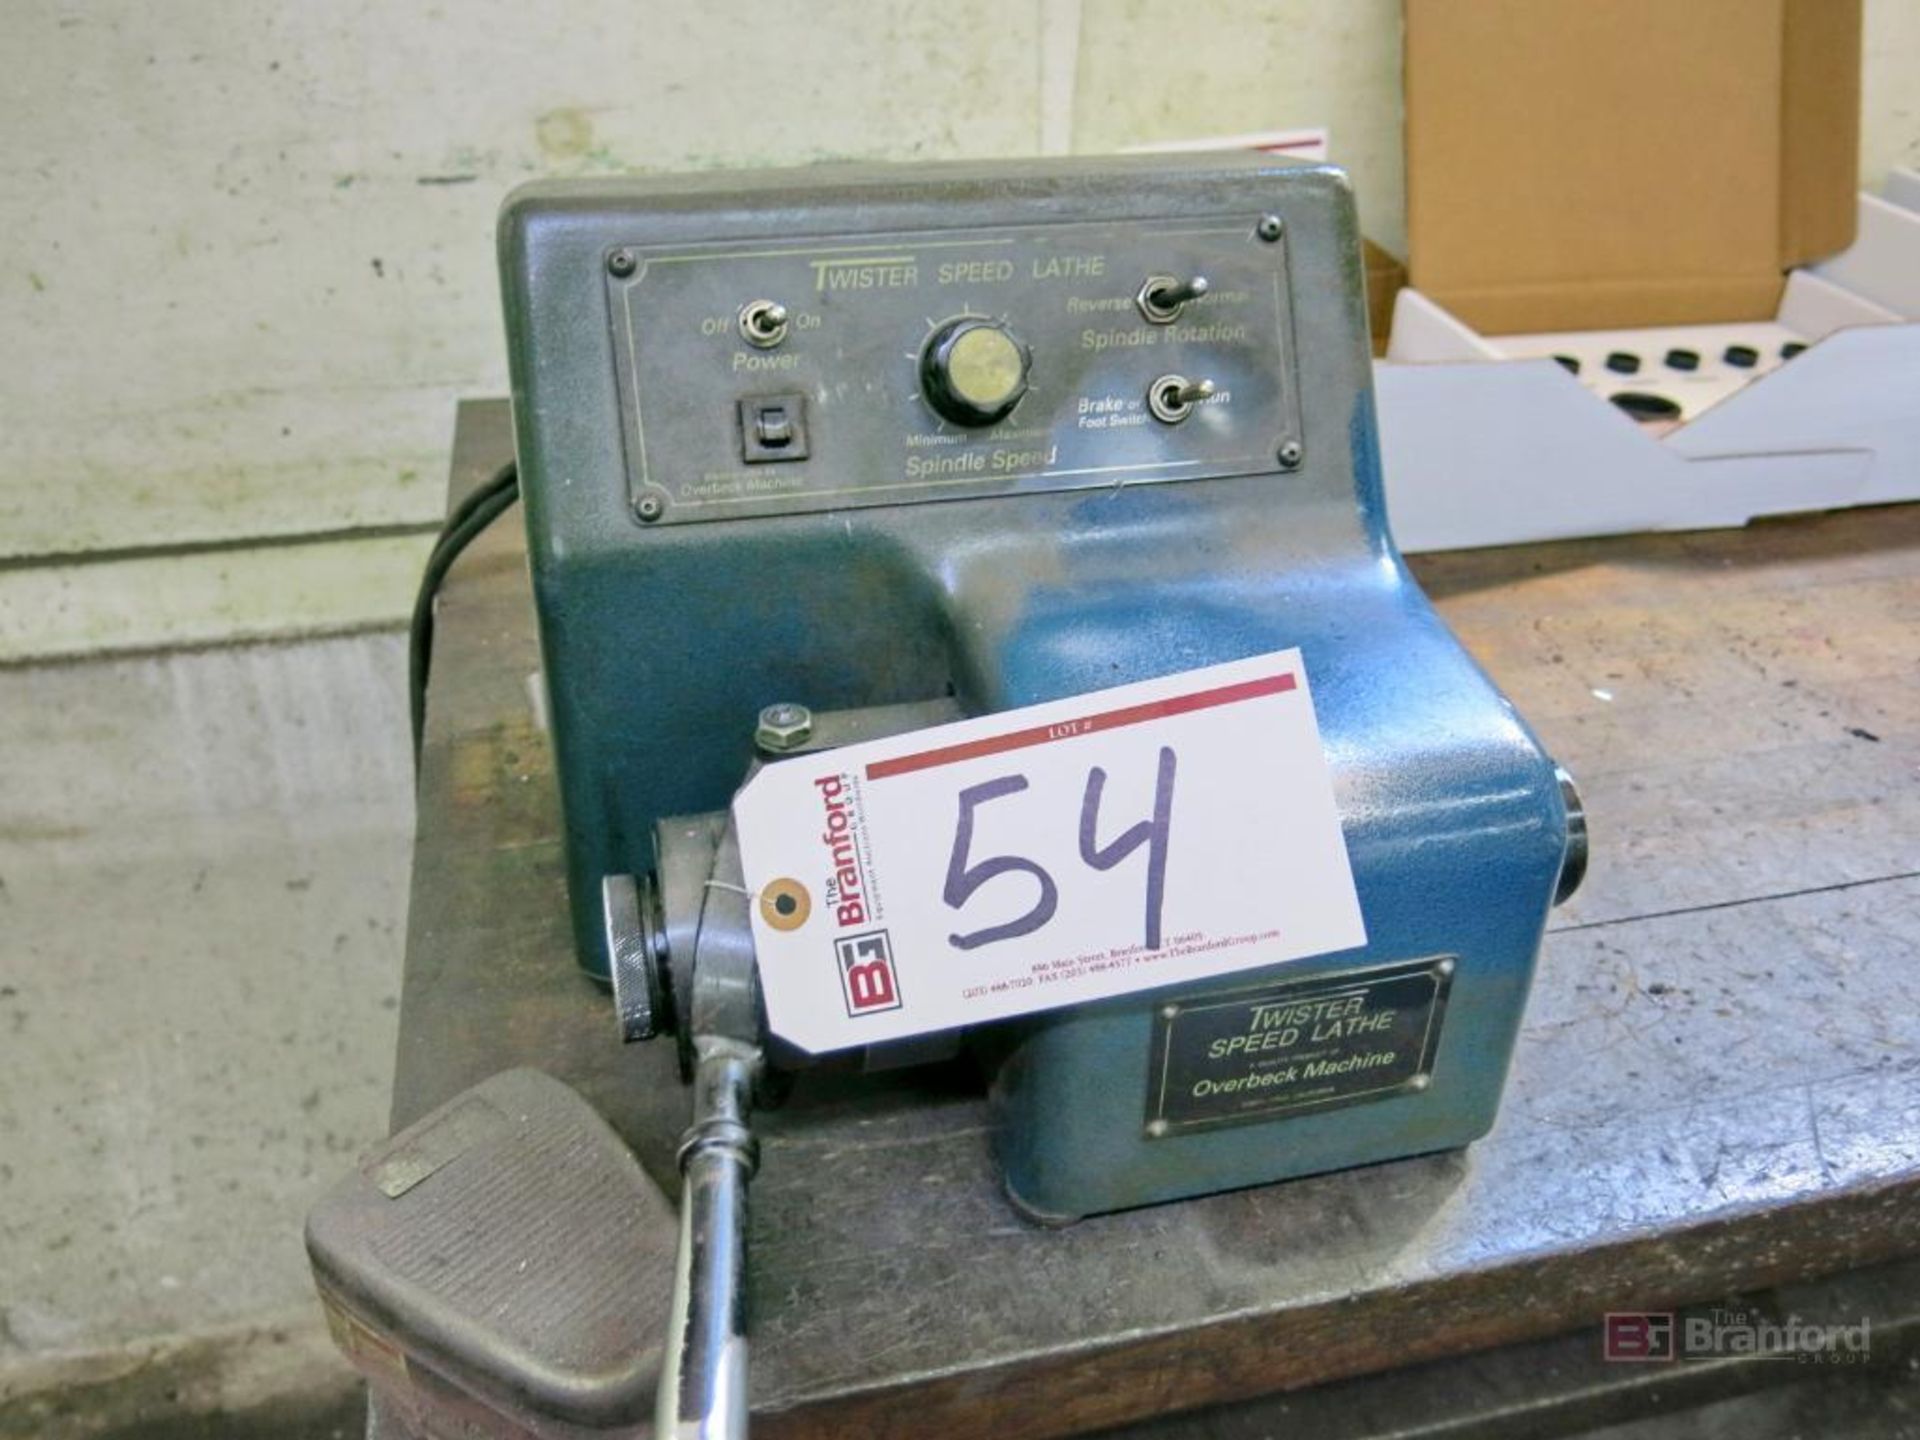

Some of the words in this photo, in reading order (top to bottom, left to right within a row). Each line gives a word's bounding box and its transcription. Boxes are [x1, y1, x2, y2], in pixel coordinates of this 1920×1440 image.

[810, 256, 919, 291] TWISTER
[938, 262, 1014, 285] SPEED
[1032, 256, 1105, 278] LATHE
[1066, 297, 1132, 313] Reverse
[702, 318, 729, 335] Off
[796, 312, 821, 329] On
[1081, 328, 1158, 350] Spindle
[1164, 322, 1246, 344] Rotation
[732, 352, 800, 372] Power
[1078, 395, 1123, 414] Brake
[1078, 415, 1107, 429] Foot
[905, 433, 968, 448] Minimum
[905, 452, 986, 478] Spindle
[991, 444, 1058, 472] Speed
[1049, 722, 1077, 739] LOT
[841, 773, 858, 830] GROUP
[814, 774, 865, 927] Branford
[943, 746, 1177, 951] 54
[826, 876, 839, 909] The
[1250, 989, 1370, 1032] TWISTER
[1207, 1027, 1300, 1059] SPEED
[1311, 1009, 1397, 1042] LATHE
[1192, 1066, 1299, 1098] Overbeck
[1303, 1051, 1396, 1082] Machine
